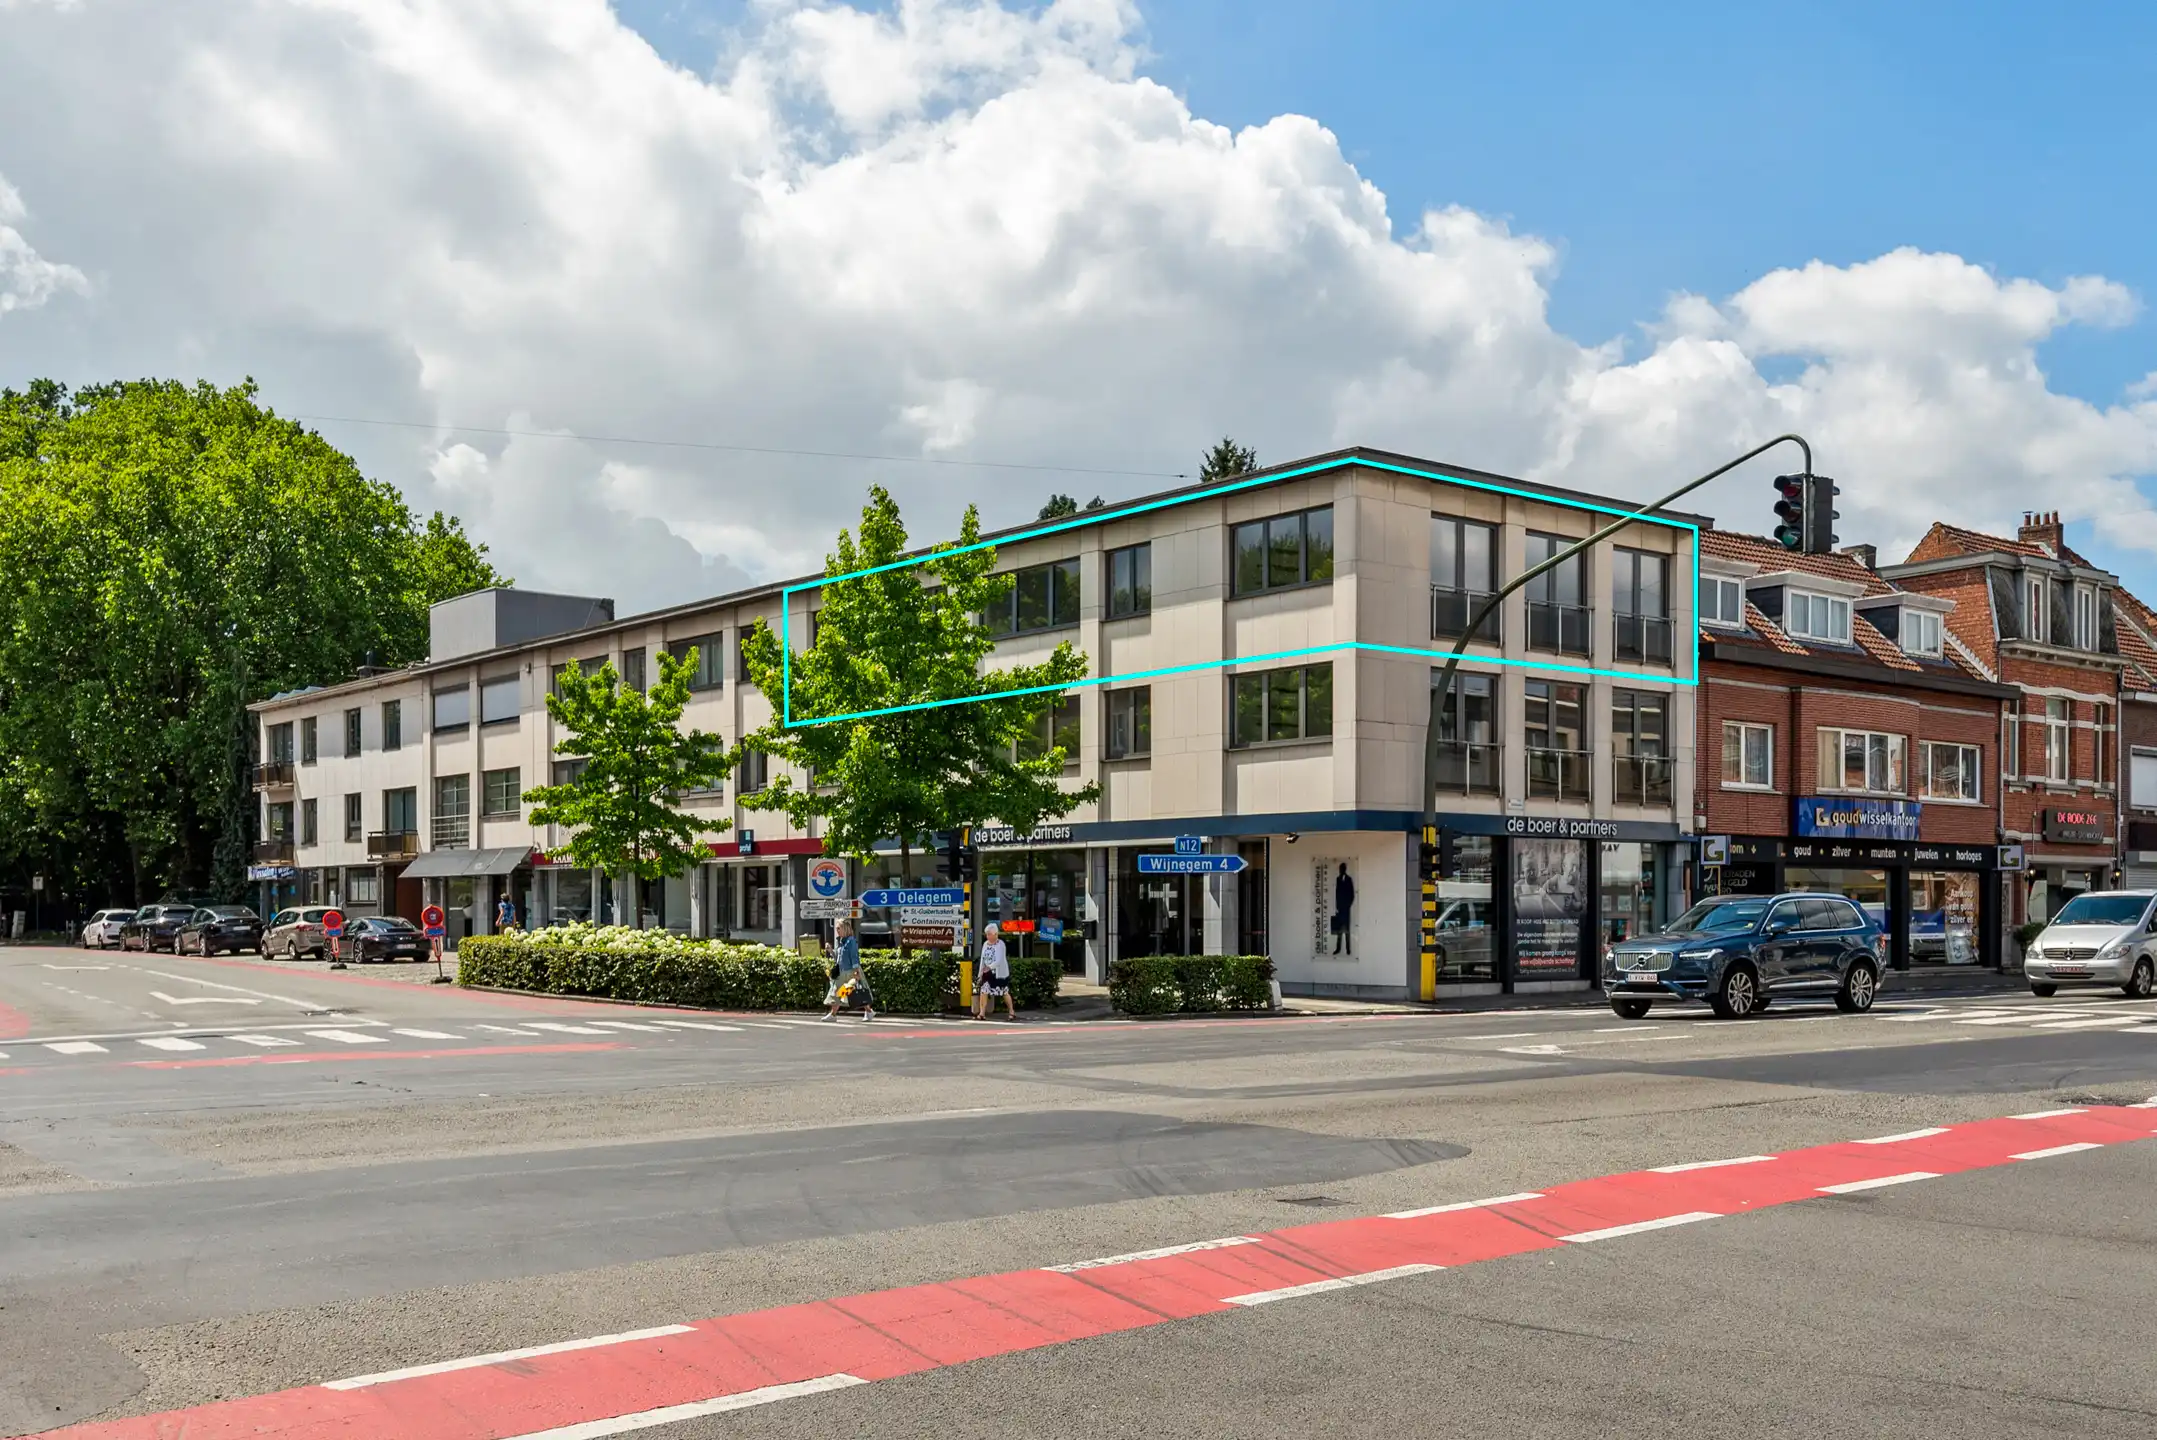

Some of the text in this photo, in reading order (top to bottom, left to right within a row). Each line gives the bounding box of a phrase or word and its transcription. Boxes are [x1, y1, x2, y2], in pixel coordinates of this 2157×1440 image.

[2057, 812, 2097, 825] DE RODE ZEE
[1507, 816, 1618, 837] de boer & partners
[974, 829, 988, 843] de
[990, 828, 1014, 842] boer
[1026, 825, 1071, 843] partners
[1180, 839, 1197, 852] N12
[1793, 844, 1982, 863] goud zilver munten juwelen horloges
[1150, 857, 1228, 872] Wijnegem 4
[823, 900, 851, 908] PARKING
[880, 891, 952, 905] 3 Oelegem
[911, 917, 962, 926] Containerpark
[908, 927, 945, 936] Vrieselhof
